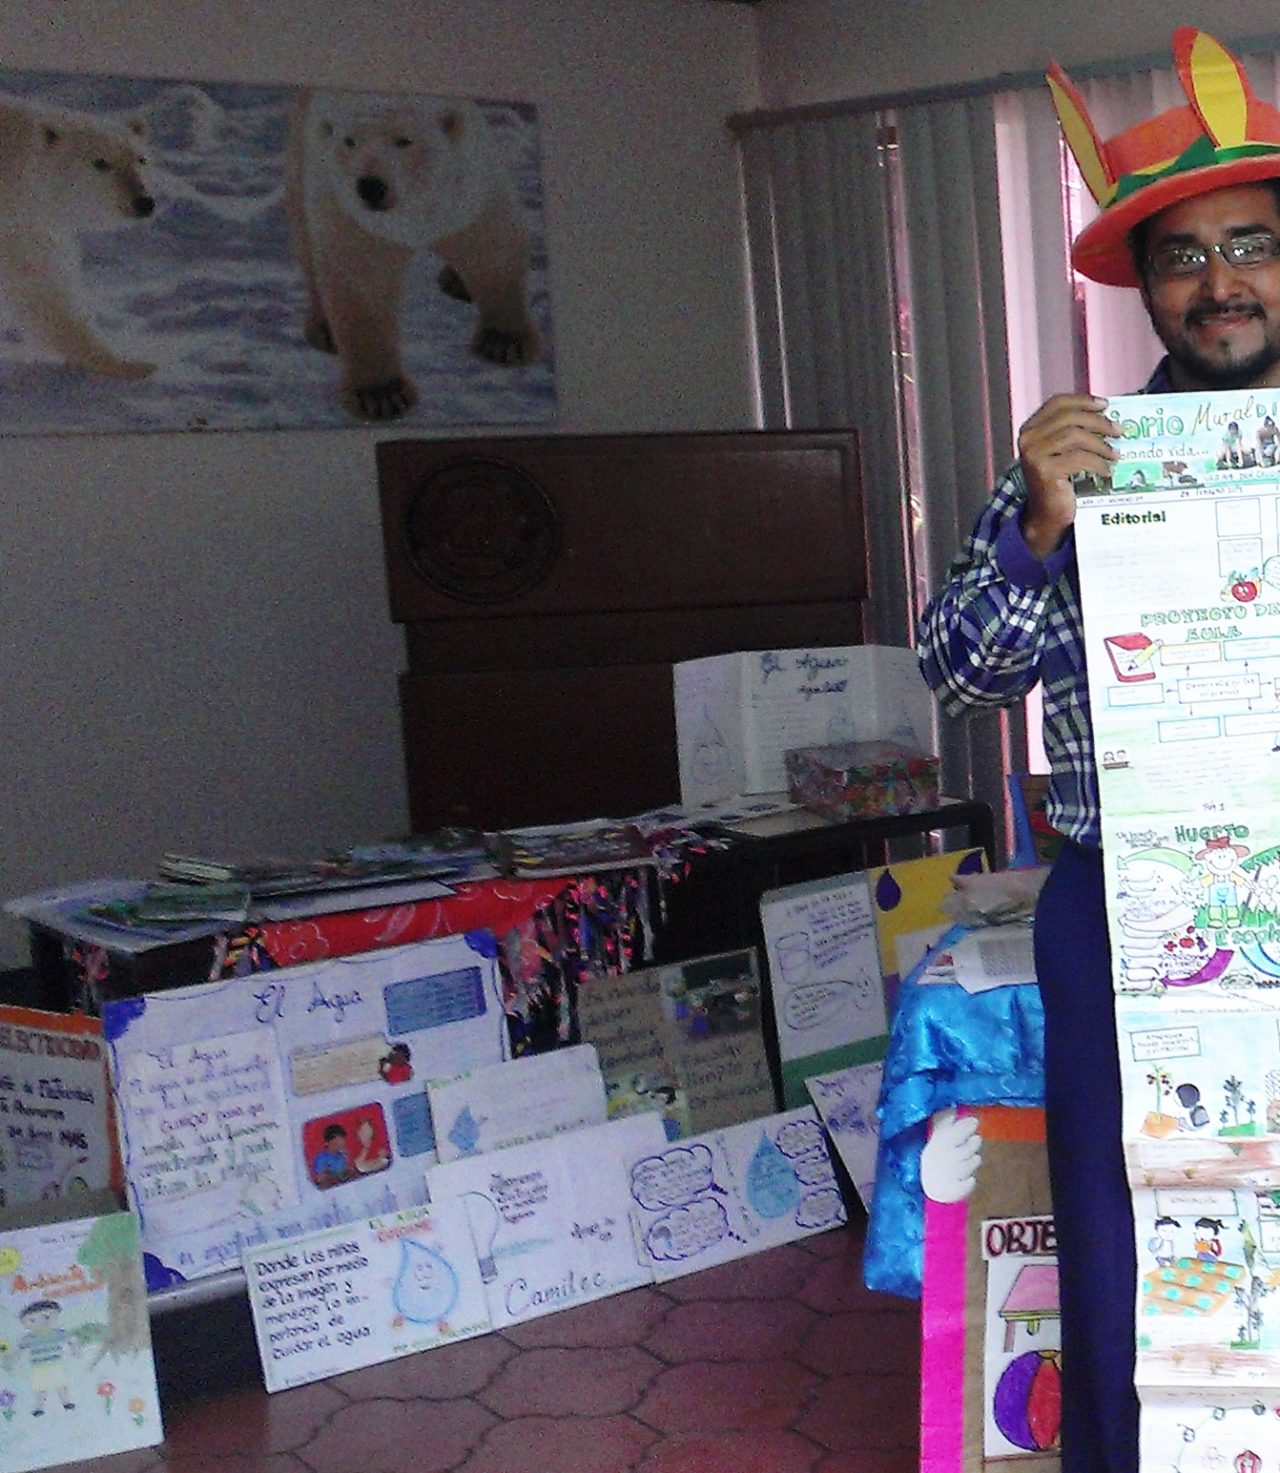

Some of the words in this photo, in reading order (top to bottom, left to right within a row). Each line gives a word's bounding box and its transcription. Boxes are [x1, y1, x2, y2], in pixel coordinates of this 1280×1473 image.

[1189, 395, 1256, 437] Mural
[1101, 509, 1166, 526] Editorial
[1141, 604, 1248, 628] PROYECTO
[1186, 625, 1243, 642] AULA
[1175, 823, 1250, 843] HUERTO
